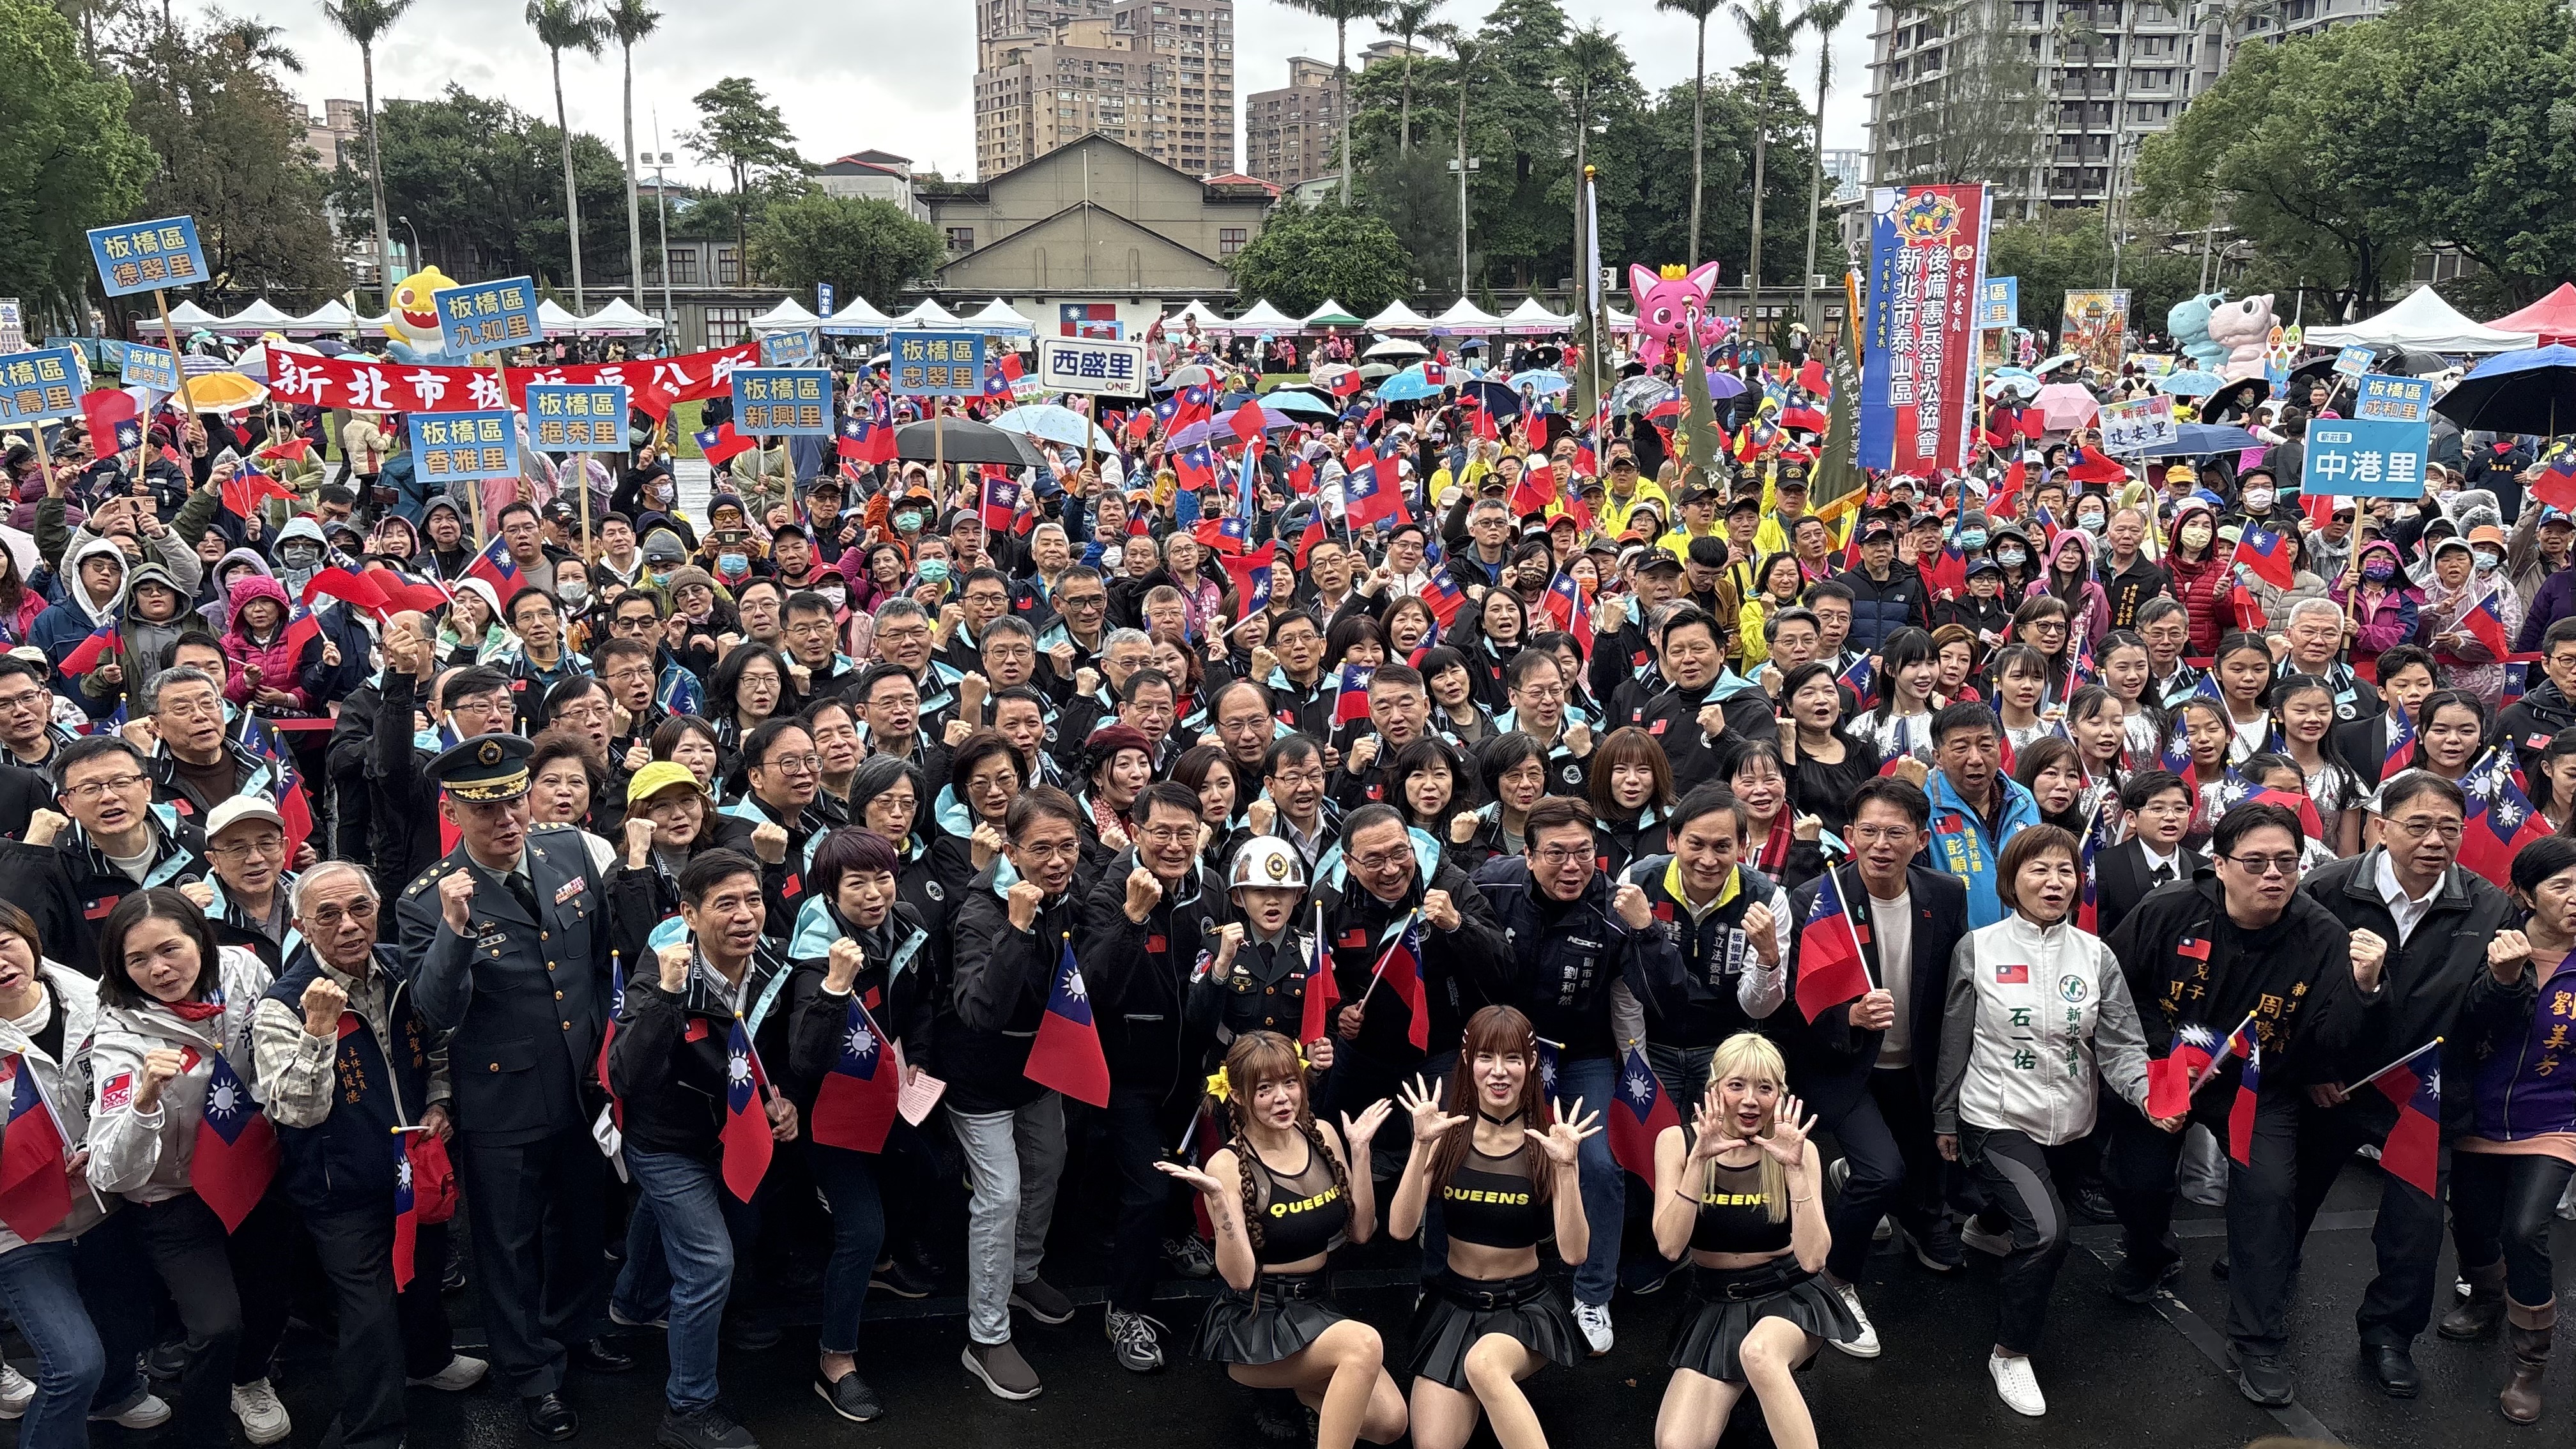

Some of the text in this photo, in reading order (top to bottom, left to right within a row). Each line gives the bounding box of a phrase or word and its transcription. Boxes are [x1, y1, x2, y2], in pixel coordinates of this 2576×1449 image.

[102, 226, 189, 260] 板橋區
[111, 253, 197, 288] 德翠里
[447, 286, 527, 320] 板橋區
[454, 314, 533, 348] 九如里
[772, 334, 804, 349] 板橋區
[1890, 247, 1924, 405] 新北市泰山區
[129, 349, 172, 370] 板橋區
[901, 339, 975, 362] 板橋區
[1052, 349, 1134, 380] 西盛里
[1916, 246, 1951, 457] 後備憲兵荷松協會
[1945, 335, 1954, 369] Republic
[0, 356, 68, 388] 橋區
[900, 365, 975, 389] 忠翠里
[1105, 381, 1131, 392] ONE
[537, 392, 617, 417] 板橋區
[743, 376, 822, 402] 板橋區
[1943, 378, 1952, 402] China
[2368, 380, 2425, 401] 板橋區
[744, 404, 824, 429] 新興里
[2121, 402, 2163, 420] 新莊區
[2363, 399, 2419, 419] 成和里
[421, 418, 505, 445] 板橋區
[2110, 420, 2166, 445] 建安里
[424, 447, 508, 476] 香雅里
[2315, 450, 2417, 482] 中港里
[1708, 935, 1725, 986] 立法委員
[1728, 932, 1744, 972] 板橋東區
[1558, 965, 1579, 1006] 劉和然
[1581, 957, 1595, 988] 副市長
[2008, 1007, 2037, 1070] 石一佑
[2065, 1006, 2083, 1078] 新北市議員
[2534, 990, 2576, 1077] 劉美芳
[1270, 1184, 1340, 1218] QUEENS
[1443, 1185, 1529, 1206] QUEENS
